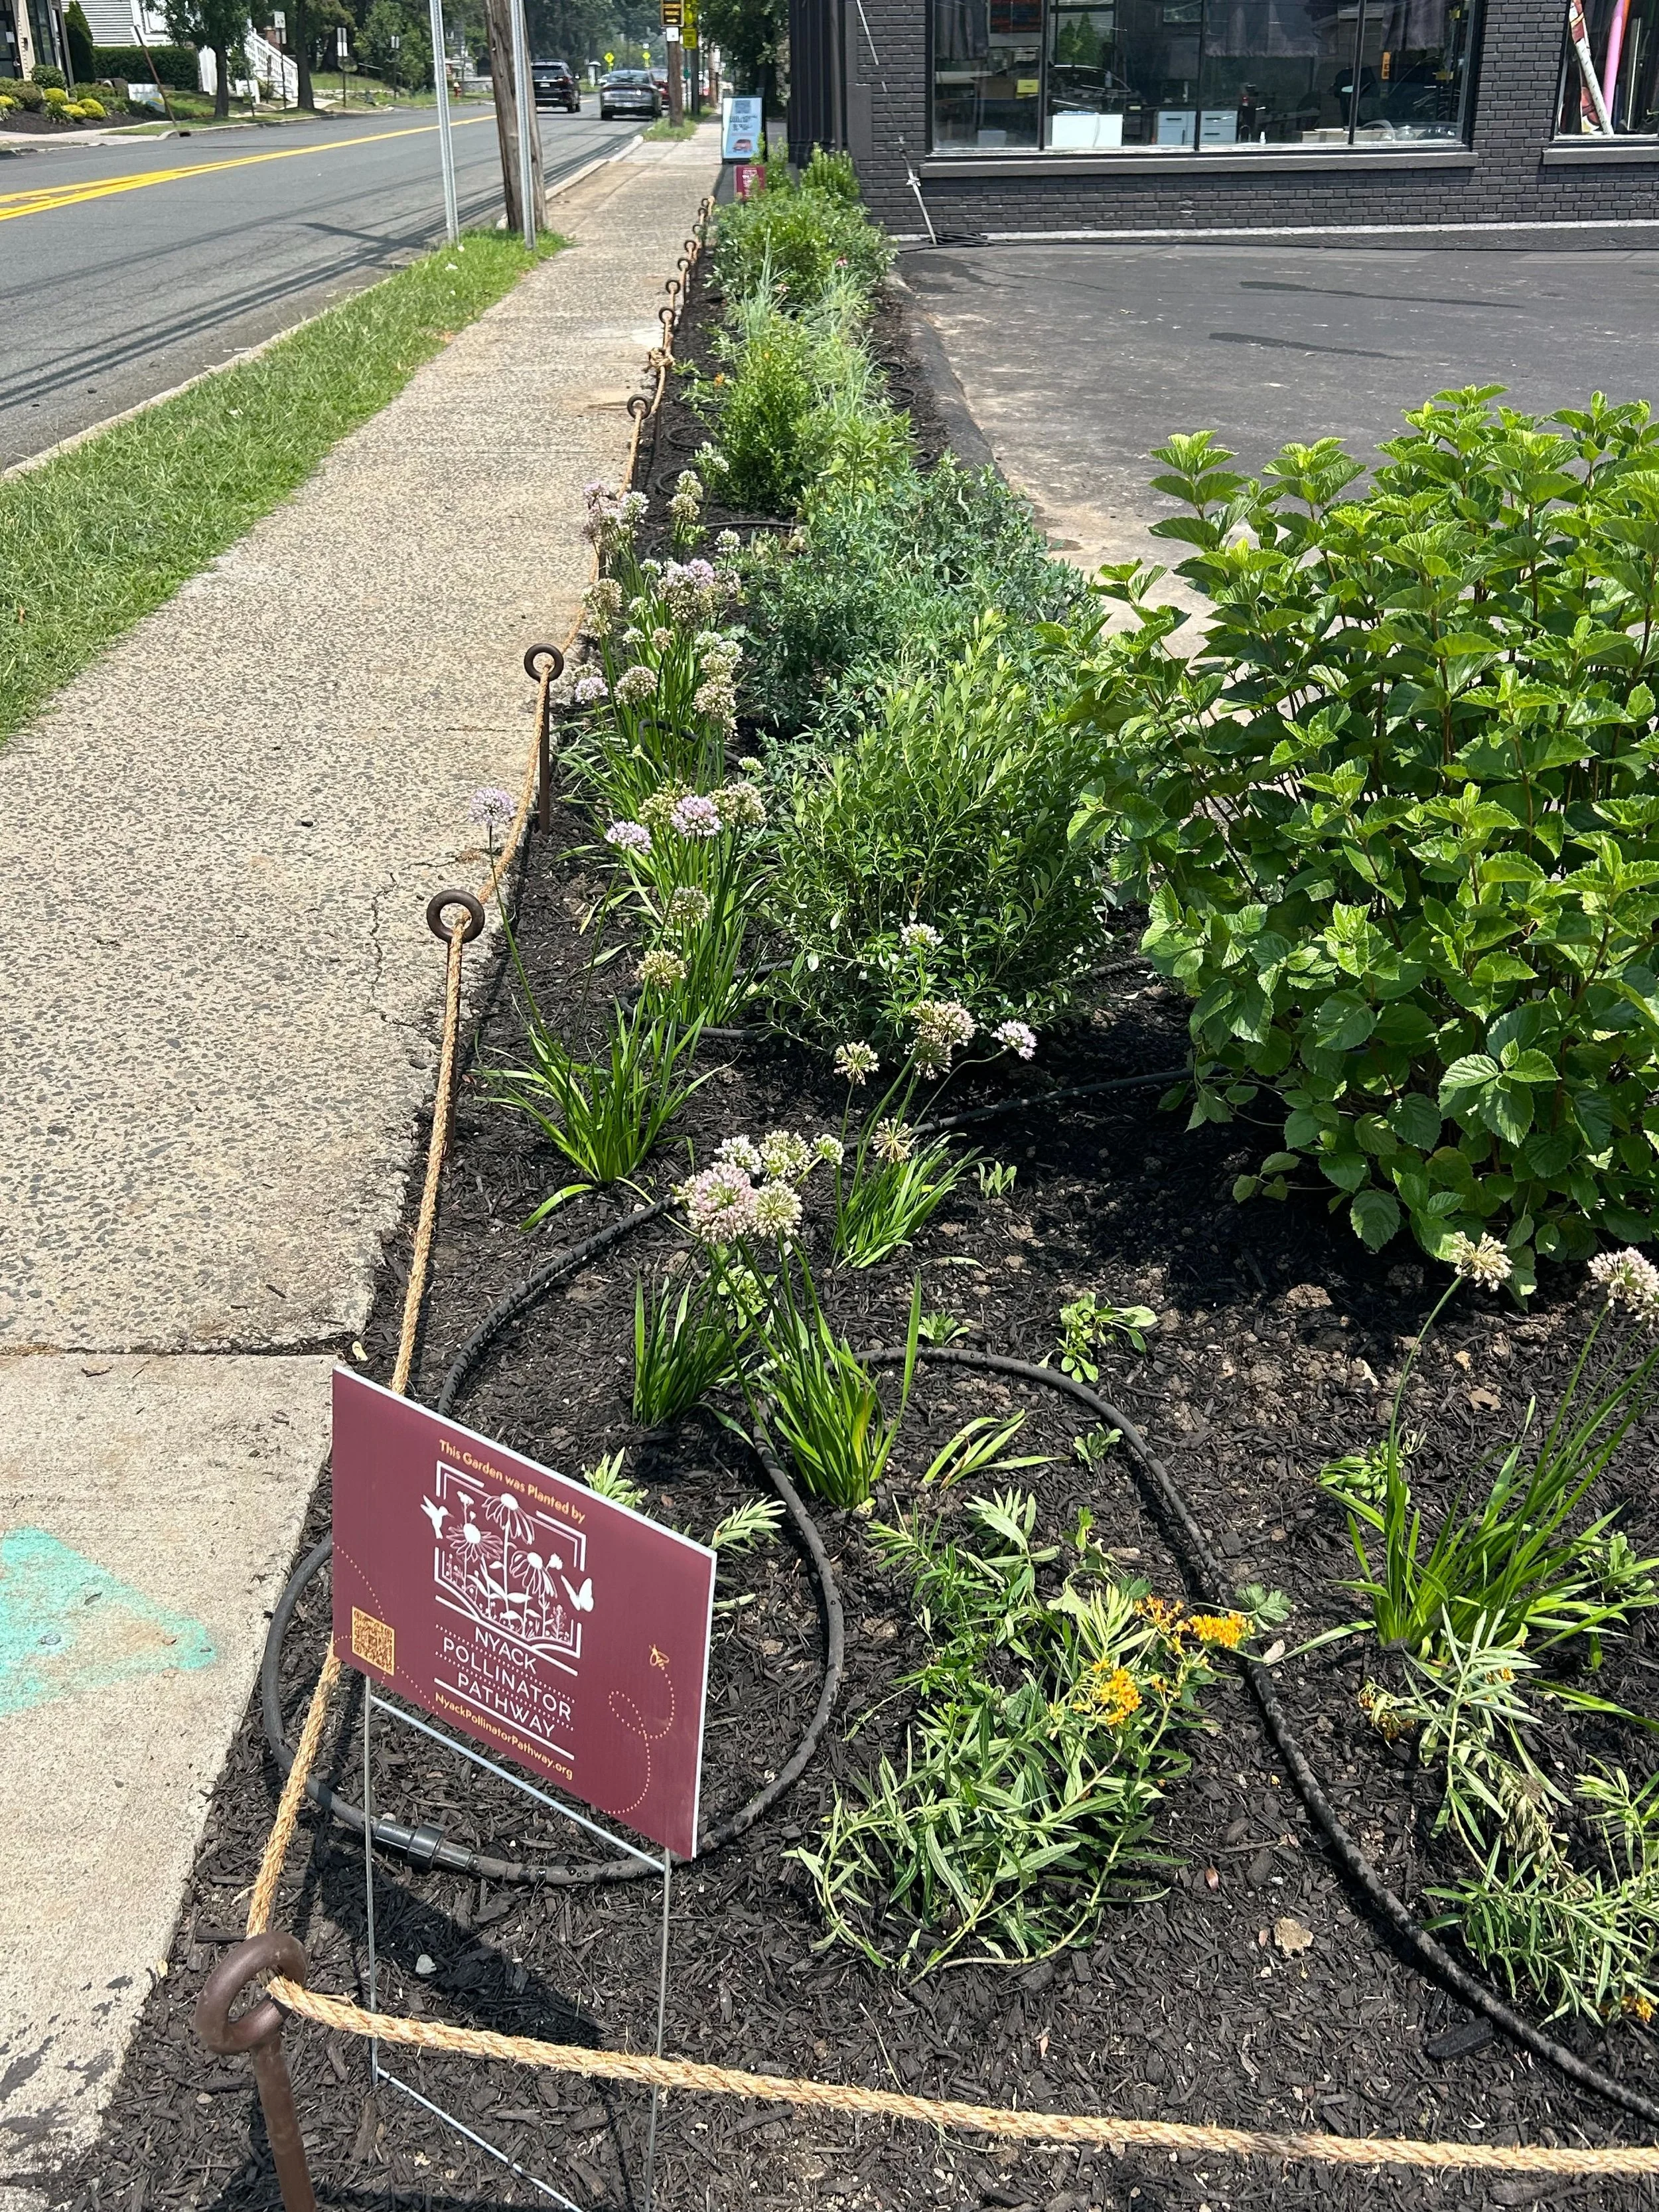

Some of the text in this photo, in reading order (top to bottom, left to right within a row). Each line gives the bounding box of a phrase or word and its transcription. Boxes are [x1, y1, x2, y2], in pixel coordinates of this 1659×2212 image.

[439, 1439, 585, 1524] This Garden was Planted by
[443, 1637, 571, 1722] POLLINATOR
[475, 1626, 537, 1674] NYACK
[435, 1692, 573, 1781] NyackPollinatorPathway.org
[458, 1672, 555, 1737] PATHWAY
